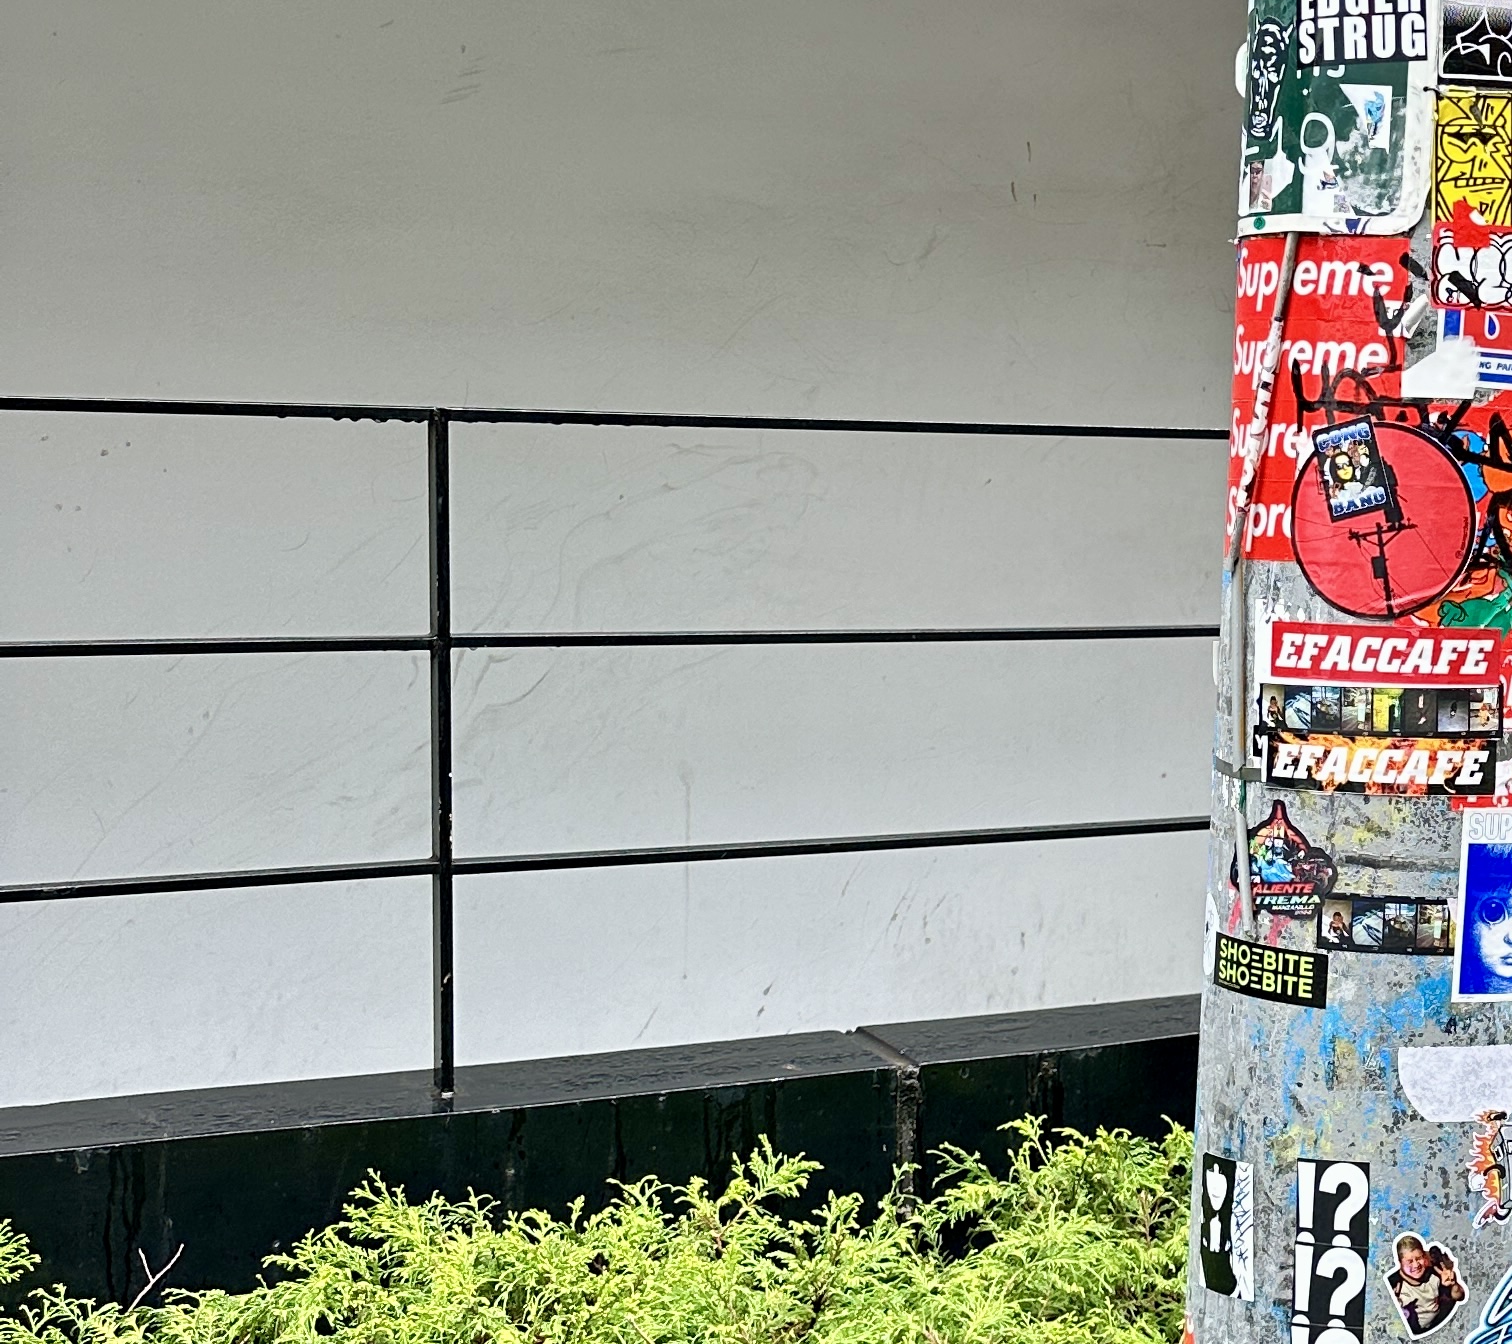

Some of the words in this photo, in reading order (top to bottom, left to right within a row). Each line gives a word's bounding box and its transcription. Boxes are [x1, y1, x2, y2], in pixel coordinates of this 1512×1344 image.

[1298, 13, 1427, 64] STRUG
[1274, 631, 1496, 677] EFACCAFE
[1271, 742, 1491, 787] EFACCAFE
